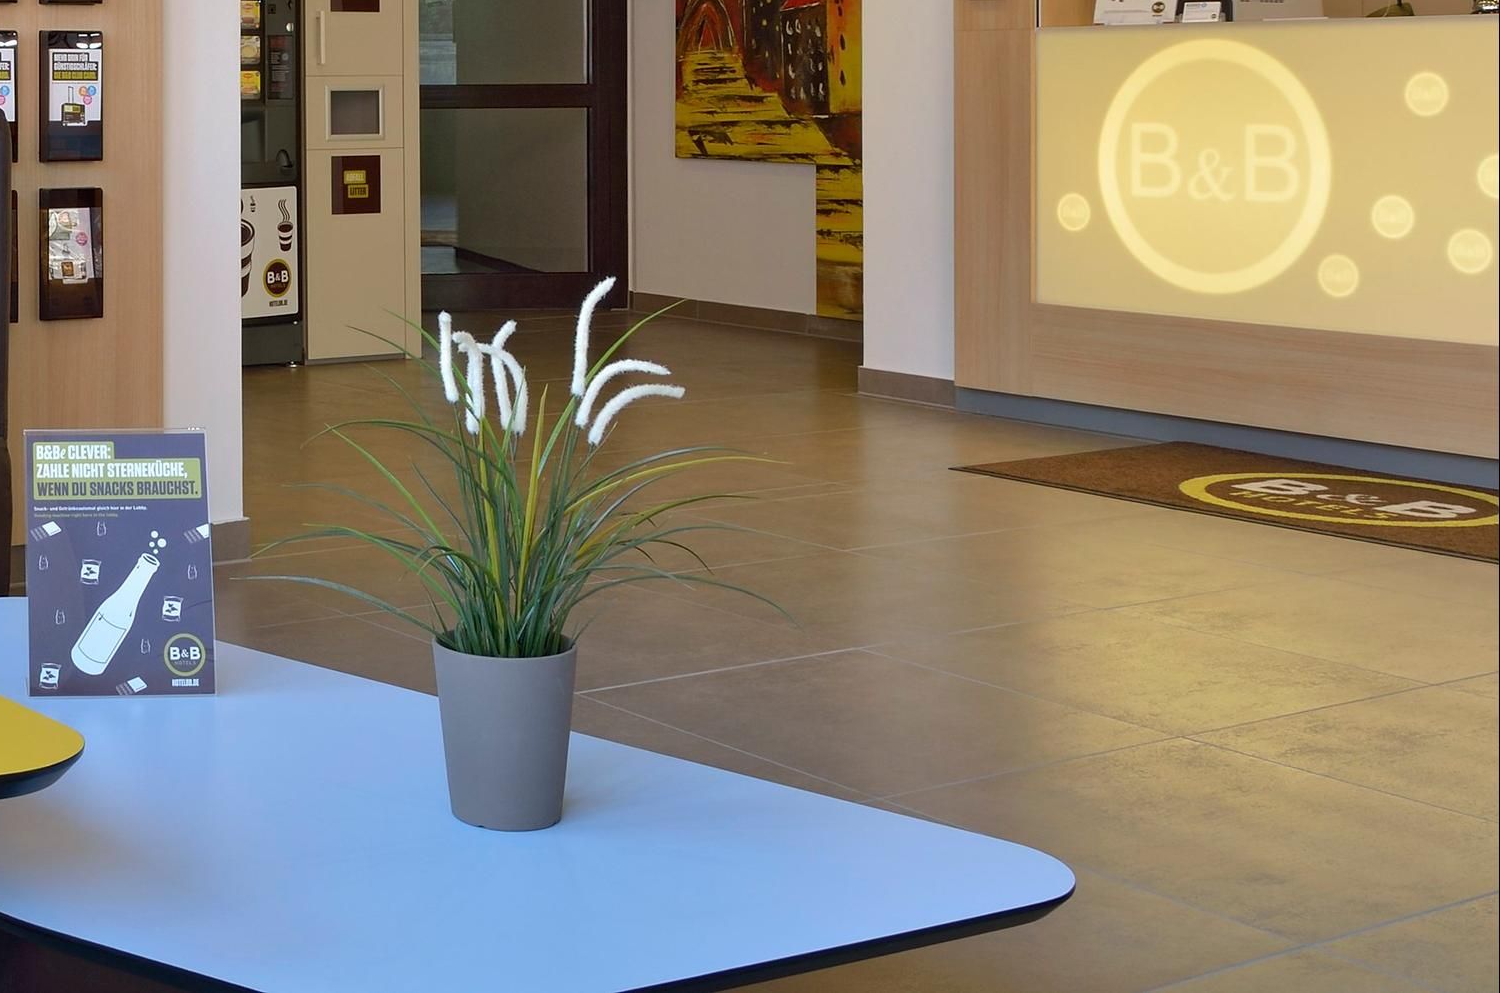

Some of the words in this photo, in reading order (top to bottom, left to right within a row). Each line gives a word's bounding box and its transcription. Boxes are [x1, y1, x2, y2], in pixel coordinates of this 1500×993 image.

[1130, 121, 1300, 203] B&B
[267, 270, 289, 284] B&B
[68, 445, 111, 460] CLEVER:
[36, 463, 69, 479] ZAHLE
[72, 463, 105, 478] NICHT
[107, 460, 188, 479] STERNEKÜCHE,
[37, 482, 69, 497] WENN
[72, 482, 87, 496] DU
[90, 481, 134, 496] SNACKS
[136, 480, 198, 495] BRAUCHST.
[1229, 491, 1400, 519] HOTELS
[1231, 478, 1477, 519] B&B
[170, 646, 201, 660] B&B
